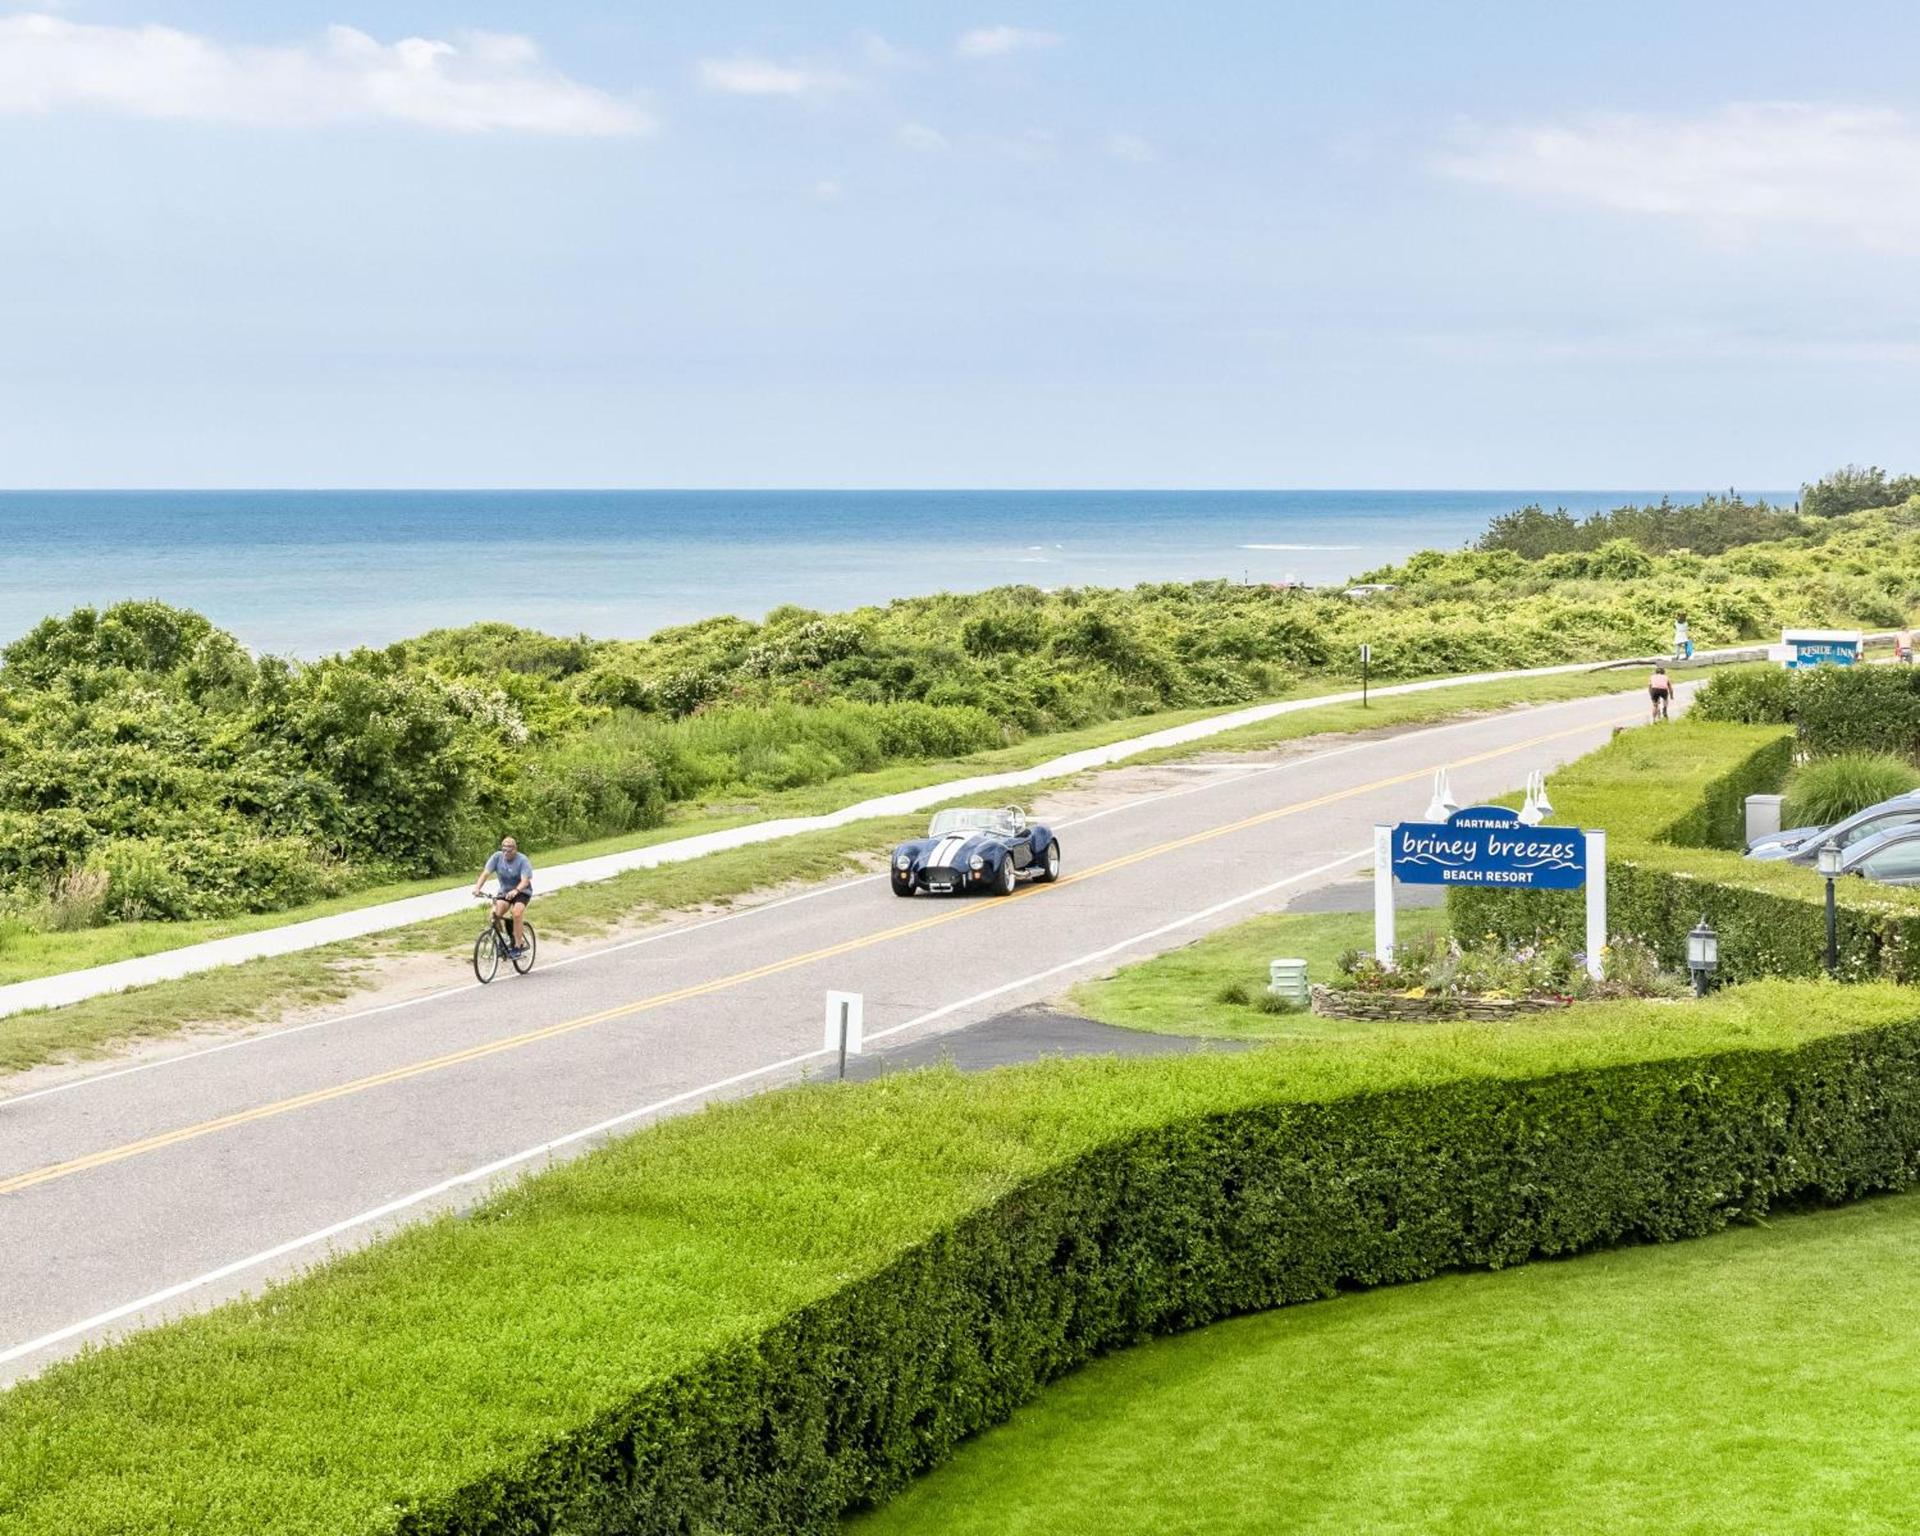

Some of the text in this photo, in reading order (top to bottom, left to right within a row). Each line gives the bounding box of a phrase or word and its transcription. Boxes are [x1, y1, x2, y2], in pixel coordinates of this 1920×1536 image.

[1837, 646, 1855, 659] INN
[1456, 819, 1520, 829] HARTMAN'S
[1403, 832, 1477, 862] briney
[1488, 834, 1575, 858] breezes
[1443, 870, 1534, 882] BEACH RESORT
